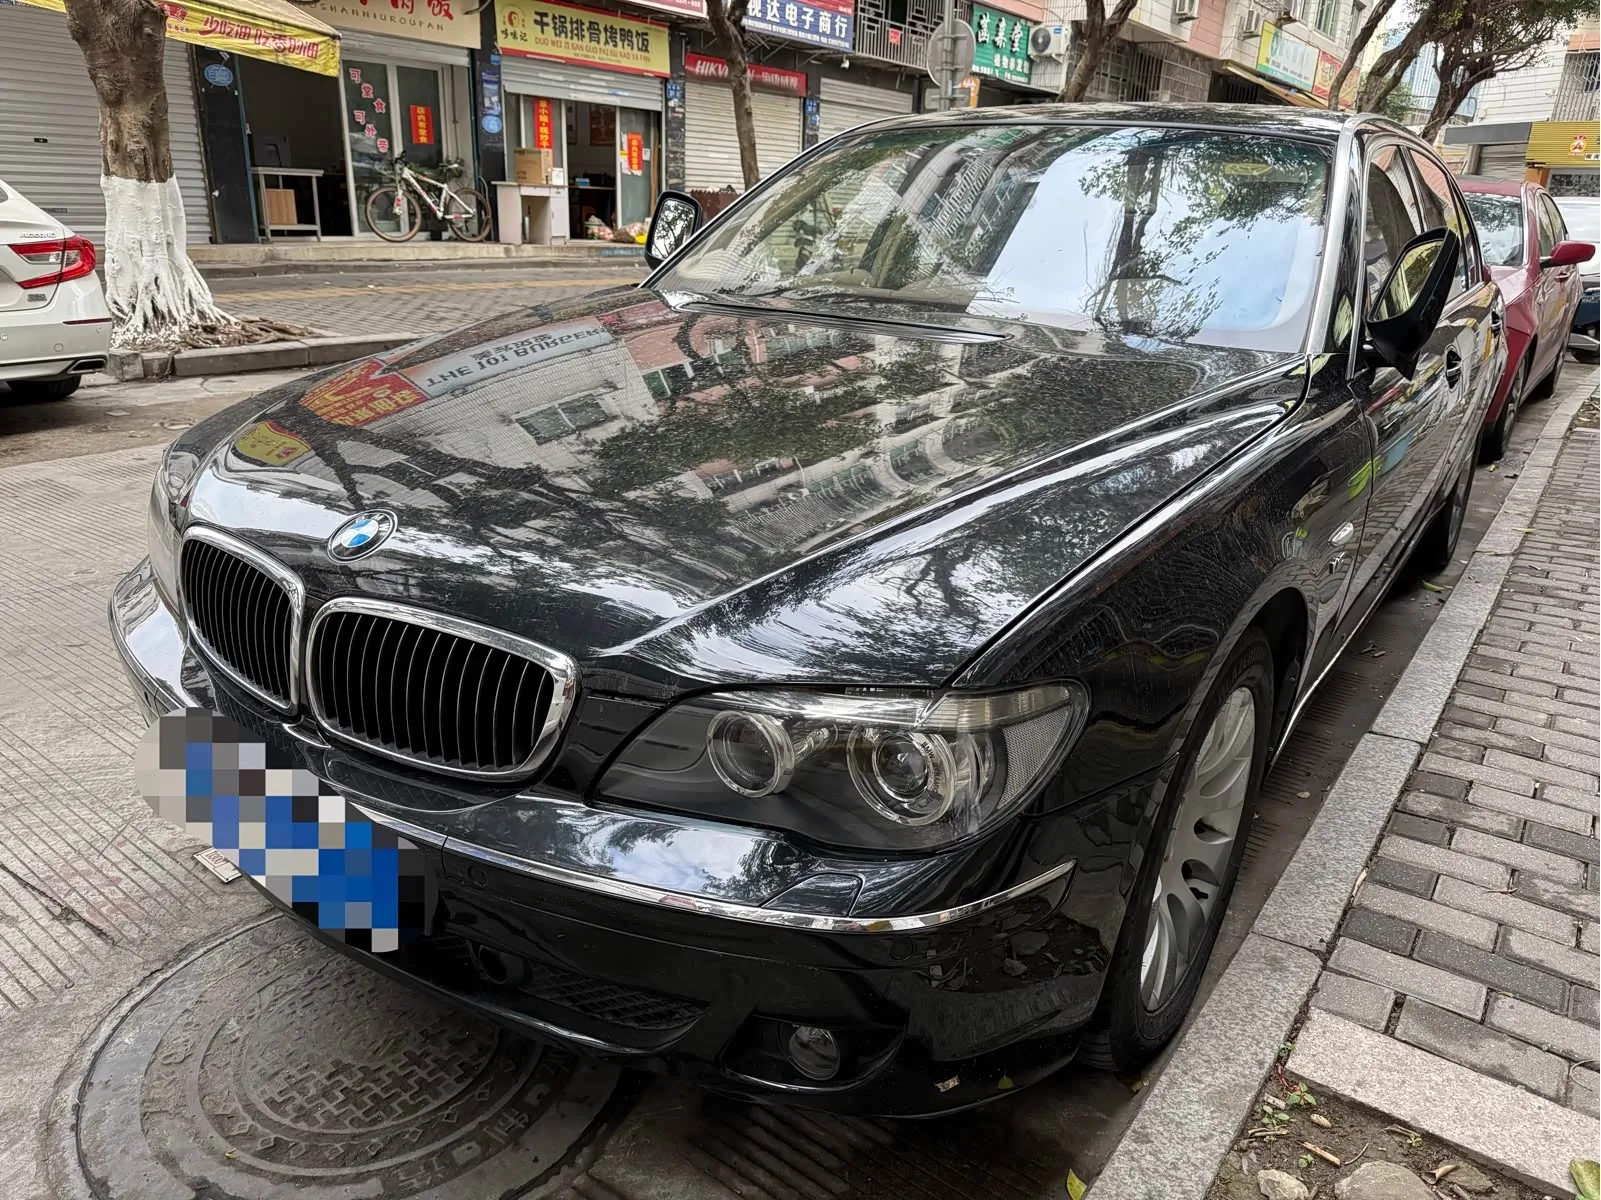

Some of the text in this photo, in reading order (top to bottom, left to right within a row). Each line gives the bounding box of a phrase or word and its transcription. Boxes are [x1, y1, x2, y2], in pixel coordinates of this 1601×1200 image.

[199, 15, 320, 60] 少吃油 吃香的油
[534, 11, 651, 53] 干锅排骨烤鸭饭
[921, 741, 936, 760] BMW
[932, 762, 941, 793] DYNAMIC
